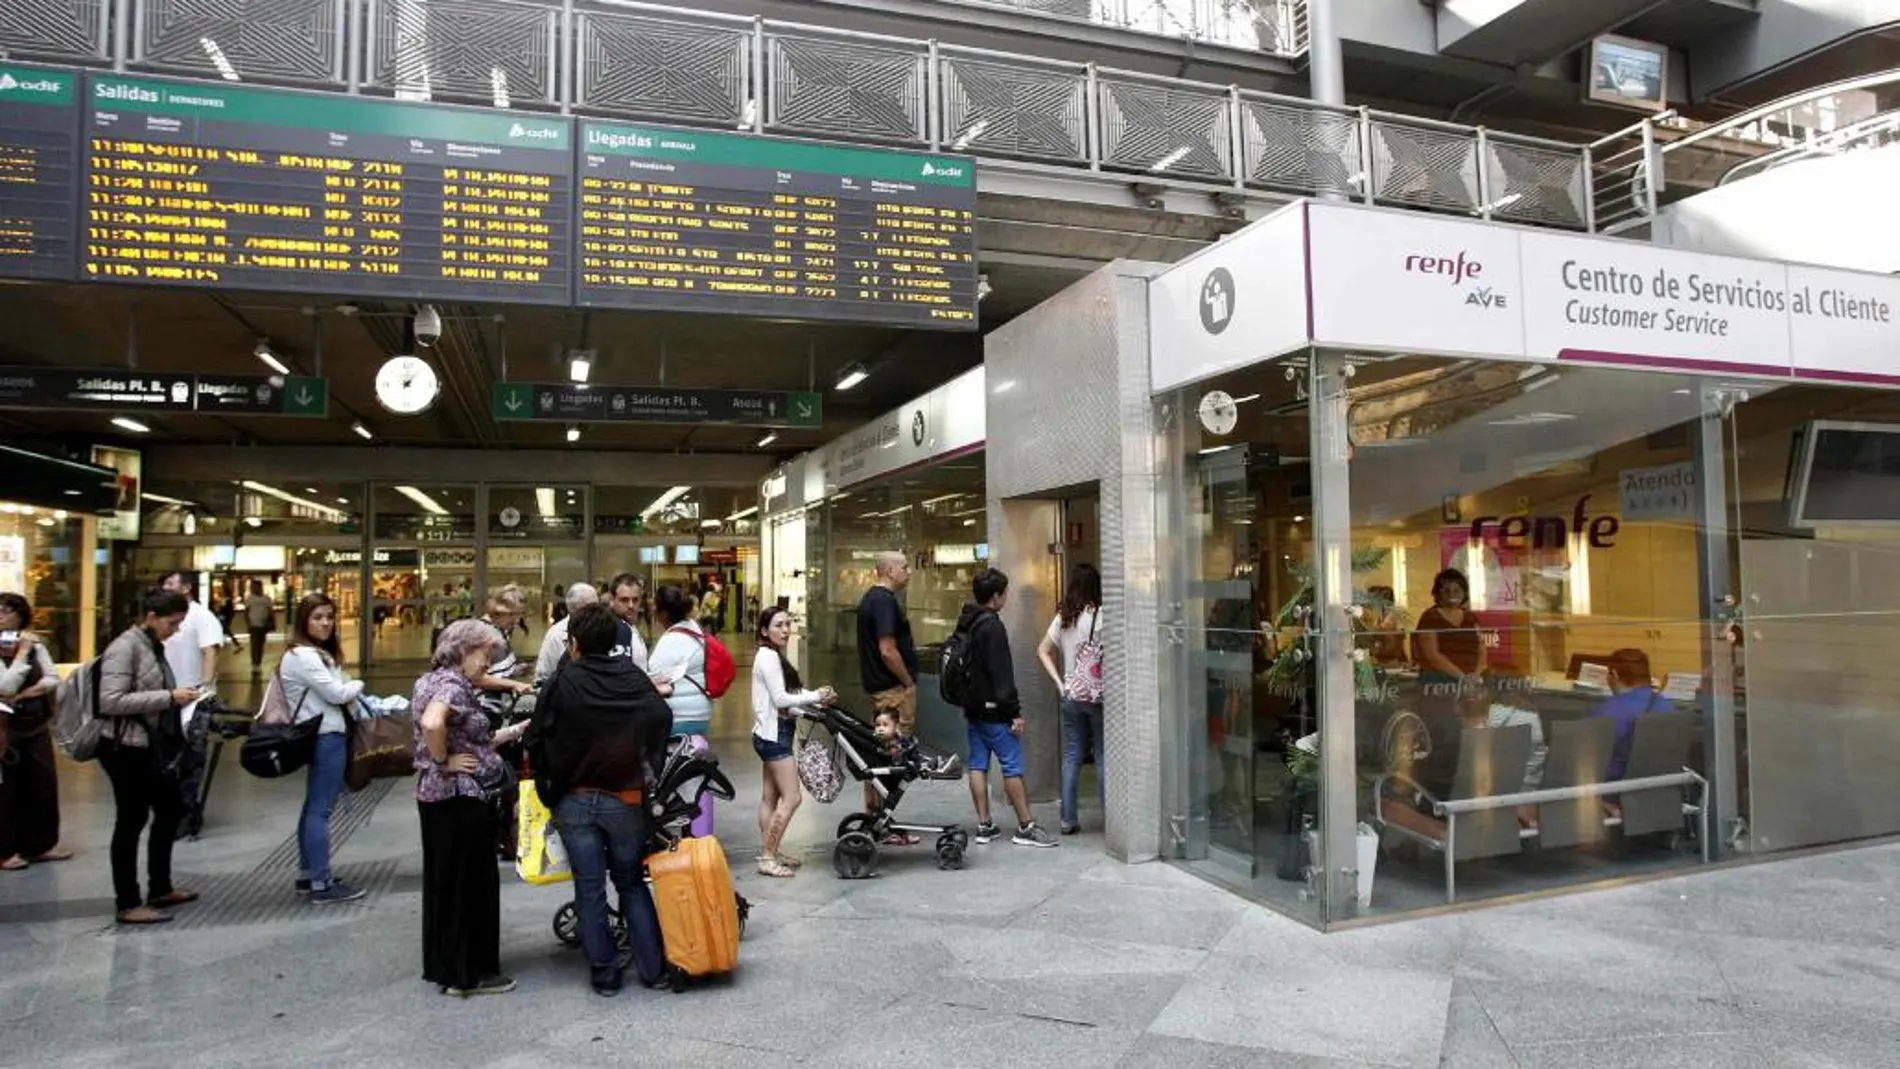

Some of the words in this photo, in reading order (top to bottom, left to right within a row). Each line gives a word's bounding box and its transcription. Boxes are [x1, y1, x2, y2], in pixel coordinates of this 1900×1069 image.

[95, 83, 159, 102] Salidas
[589, 130, 653, 148] Llegadas
[1405, 250, 1482, 284] renfe
[1464, 285, 1508, 309] AVE
[1562, 260, 1643, 299] Centro
[1652, 266, 1681, 301] de
[1688, 274, 1786, 313] Servicios
[1791, 287, 1813, 315] al
[1819, 289, 1891, 324] Cliente
[1565, 299, 1656, 330] Customer
[1664, 307, 1729, 337] Service
[77, 378, 126, 391] Salidas
[198, 382, 249, 396] Llegadas
[631, 393, 670, 405] Salidas
[1470, 495, 1619, 549] renfe
